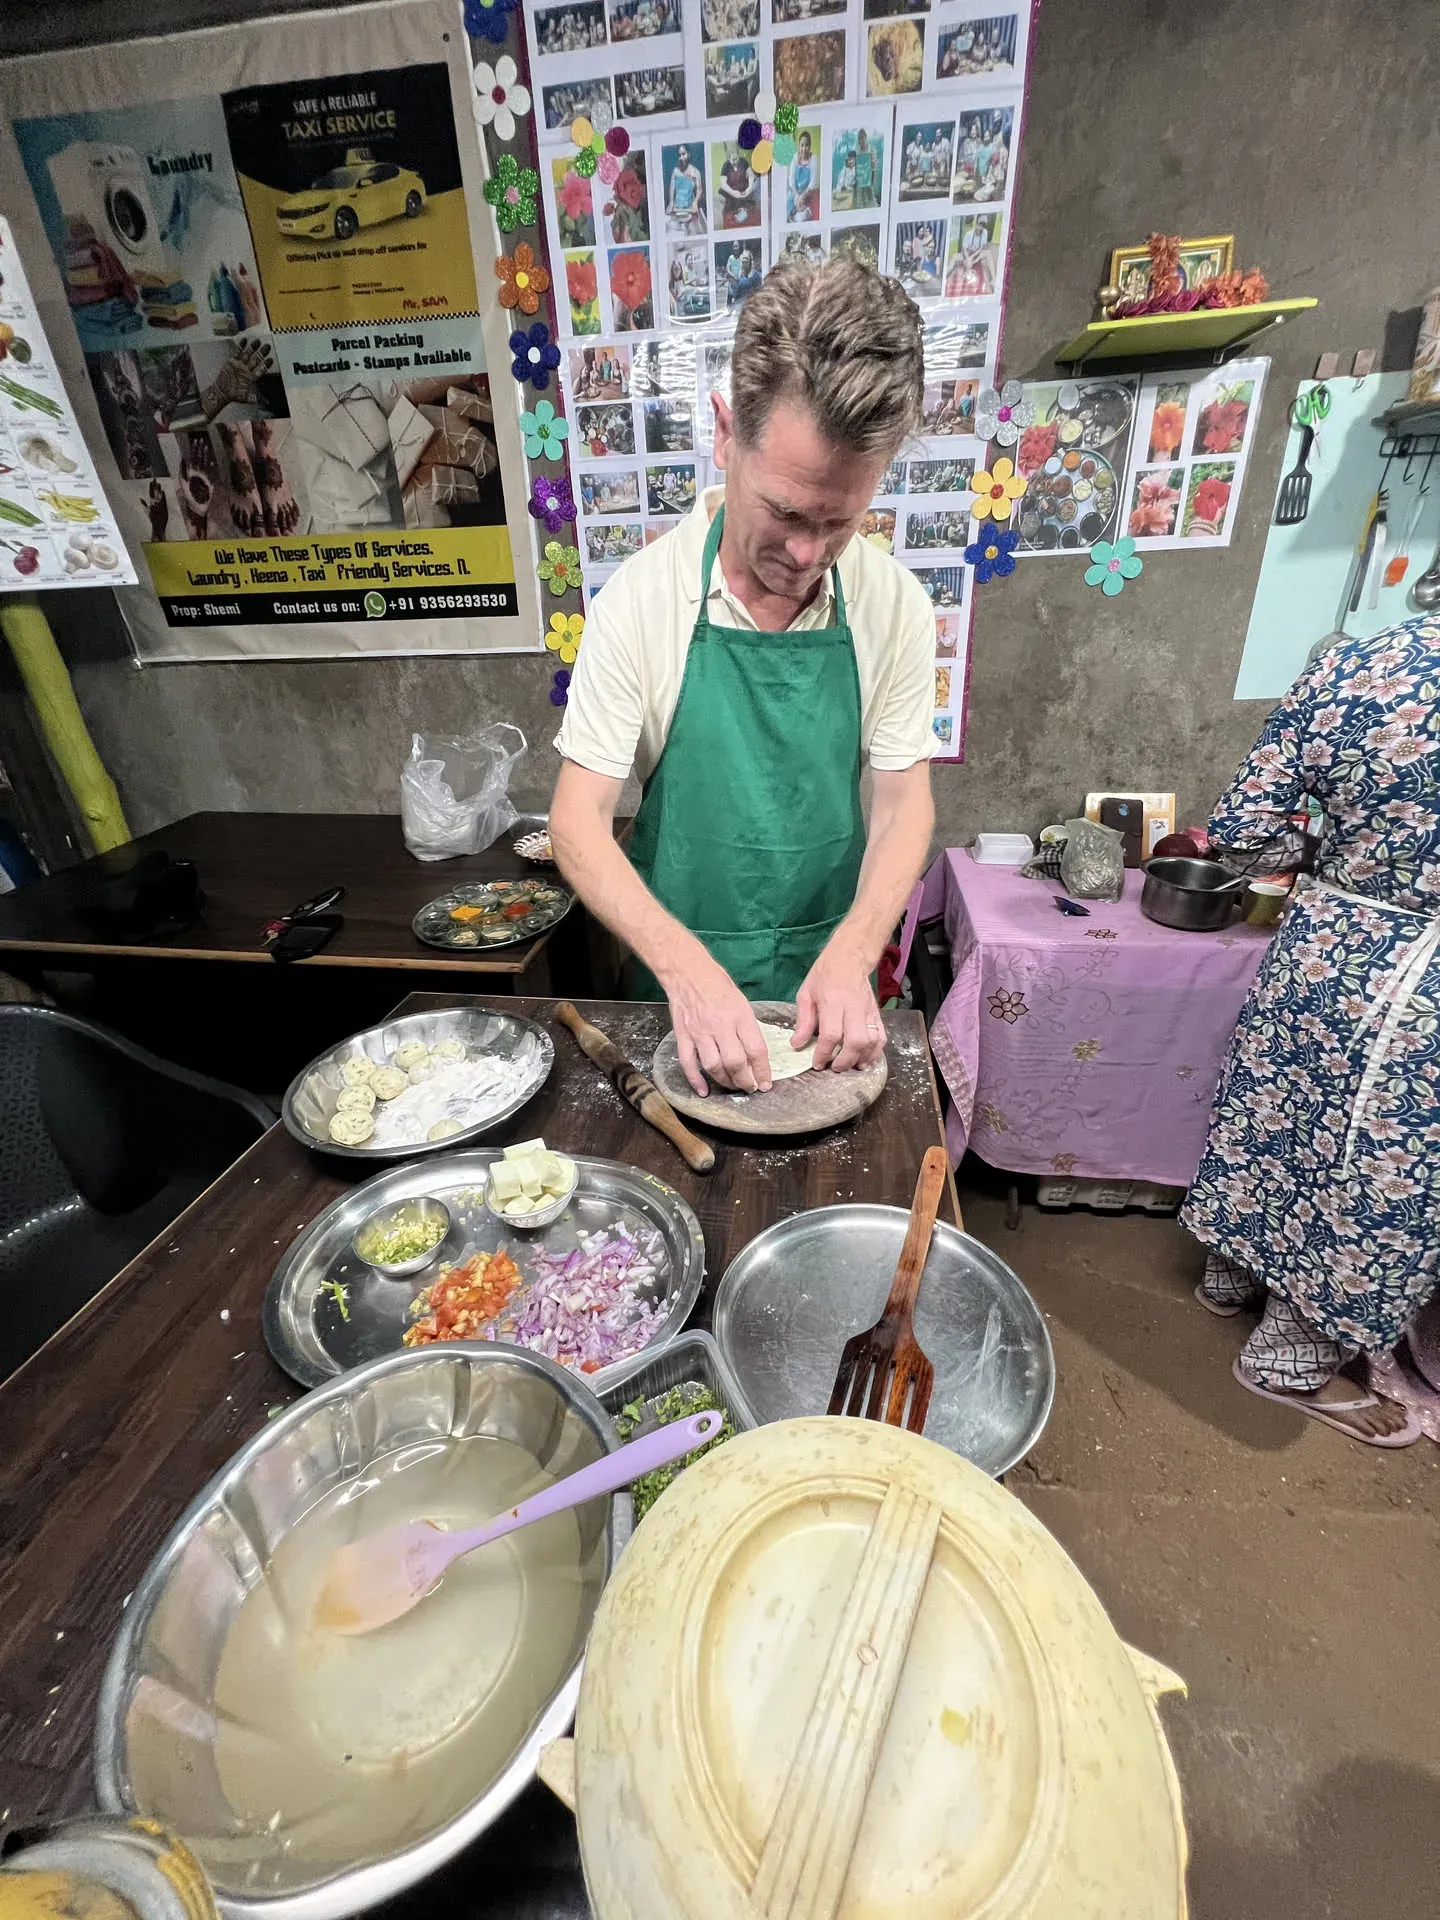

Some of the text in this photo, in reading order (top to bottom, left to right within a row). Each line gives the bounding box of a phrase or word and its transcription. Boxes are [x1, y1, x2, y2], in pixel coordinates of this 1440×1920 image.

[293, 99, 319, 114] SAFE
[328, 91, 377, 110] RELIABLE
[281, 110, 397, 139] TAXI SERVICE
[146, 152, 213, 175] Laundry
[422, 296, 448, 307] SAM
[331, 333, 424, 351] Parcel Packing
[292, 357, 351, 375] Postcards
[363, 355, 410, 370] Stamps
[414, 349, 472, 365] Available
[215, 549, 235, 565] We
[237, 548, 268, 564] Have
[269, 546, 310, 562] These
[311, 544, 352, 564] Types
[371, 540, 434, 557] Services.
[187, 569, 241, 588] Laundry
[251, 568, 289, 583] Heena
[297, 564, 326, 582] Taxi
[337, 562, 390, 582] Friendly
[392, 560, 454, 577] Services.
[171, 602, 241, 618] Prop: Shemi
[273, 594, 507, 615] Contact us on: +91 9356293530
